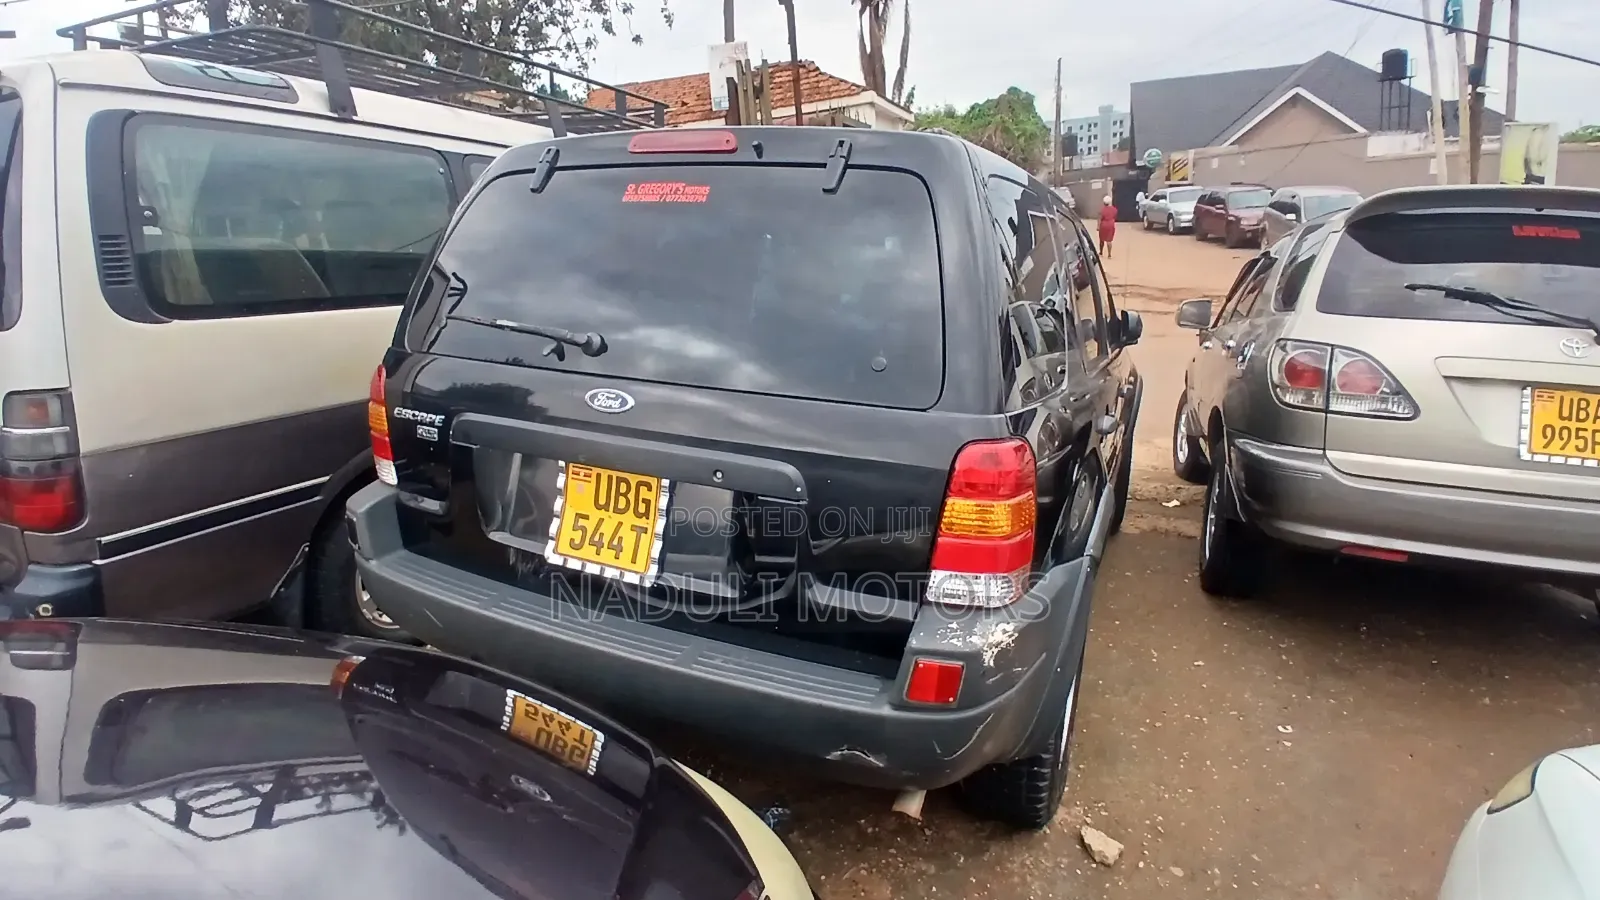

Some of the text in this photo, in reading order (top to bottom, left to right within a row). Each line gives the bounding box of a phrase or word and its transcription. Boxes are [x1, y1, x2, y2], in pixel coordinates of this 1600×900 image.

[637, 182, 686, 195] GREGORY'S
[593, 391, 622, 408] Ford
[394, 407, 445, 426] ESCAPE
[593, 472, 653, 520] UBG
[569, 512, 649, 565] 544T
